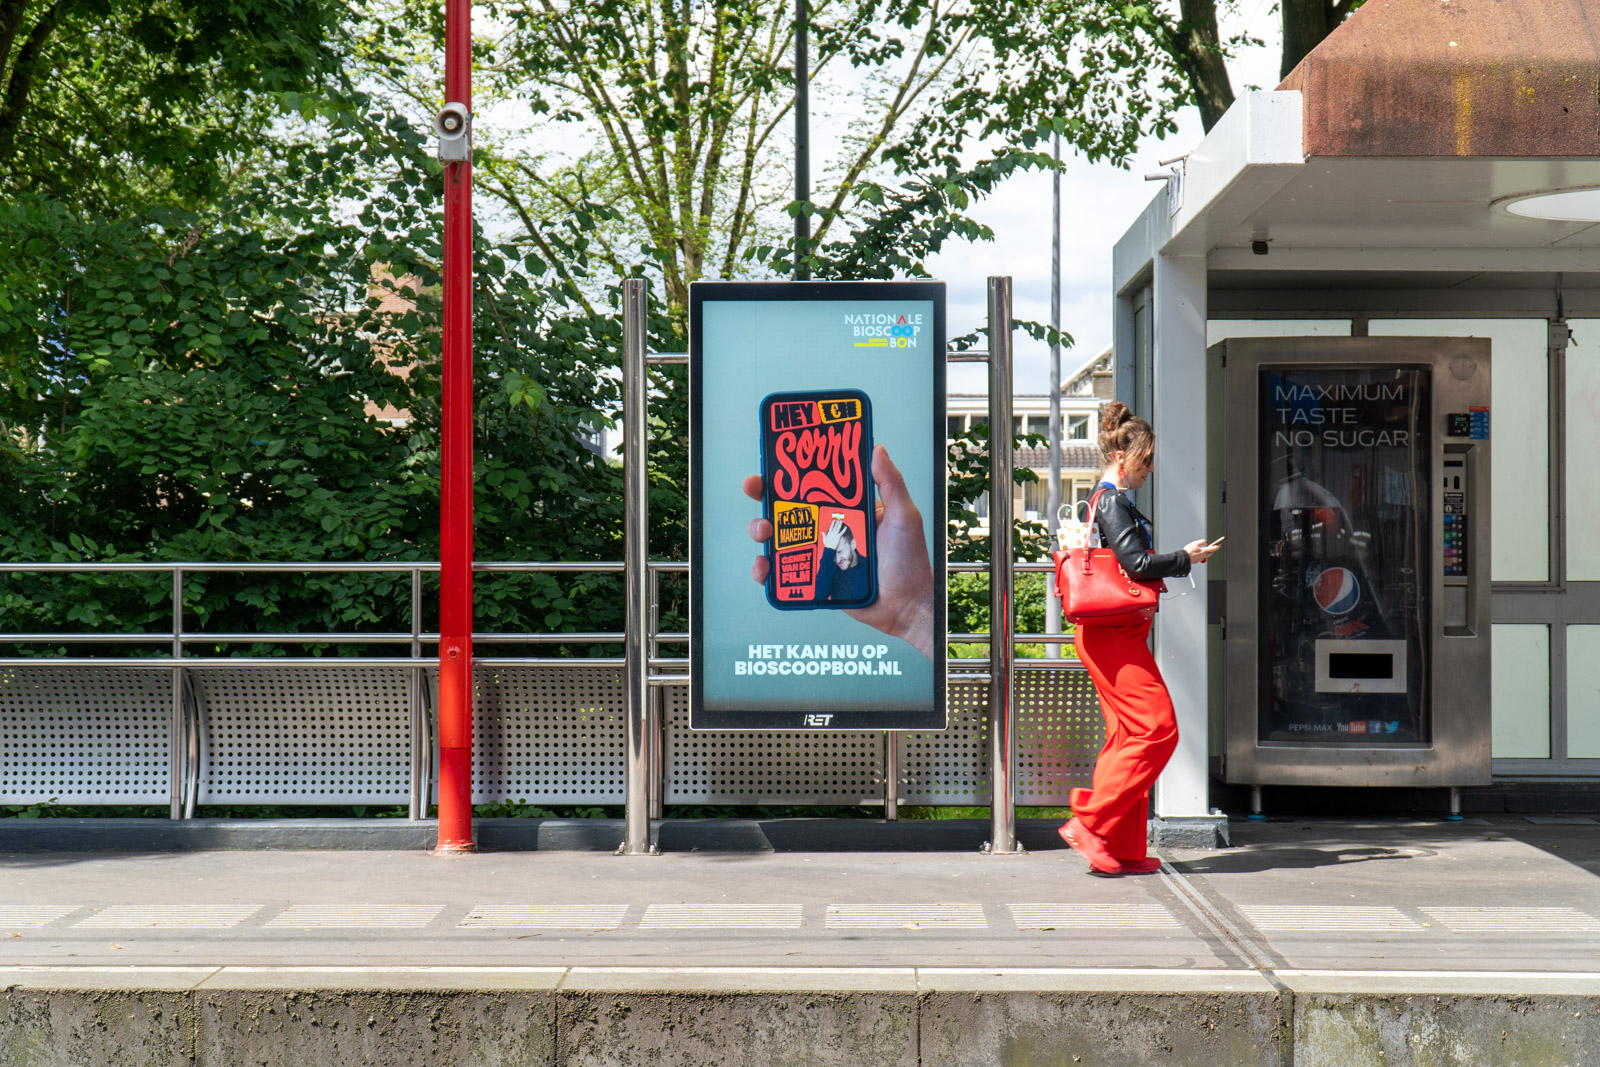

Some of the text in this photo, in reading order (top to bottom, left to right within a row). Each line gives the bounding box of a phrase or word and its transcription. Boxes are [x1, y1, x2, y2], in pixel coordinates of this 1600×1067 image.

[845, 314, 922, 324] NATIONALE
[853, 325, 920, 337] BIOSCOOP
[890, 337, 917, 348] BON
[1276, 385, 1403, 400] MAXIMUM
[774, 402, 814, 430] HEY
[1276, 408, 1357, 424] TASTE
[1276, 430, 1409, 447] NO SUGAR
[780, 527, 813, 544] MAKERTJE
[781, 552, 812, 565] GENIET
[781, 561, 811, 573] VAN DE
[781, 570, 811, 584] FILM
[749, 644, 888, 659] HET KAN NU OP
[735, 661, 902, 675] BIOSCOOPBON.NL
[1337, 721, 1366, 733] YouTube
